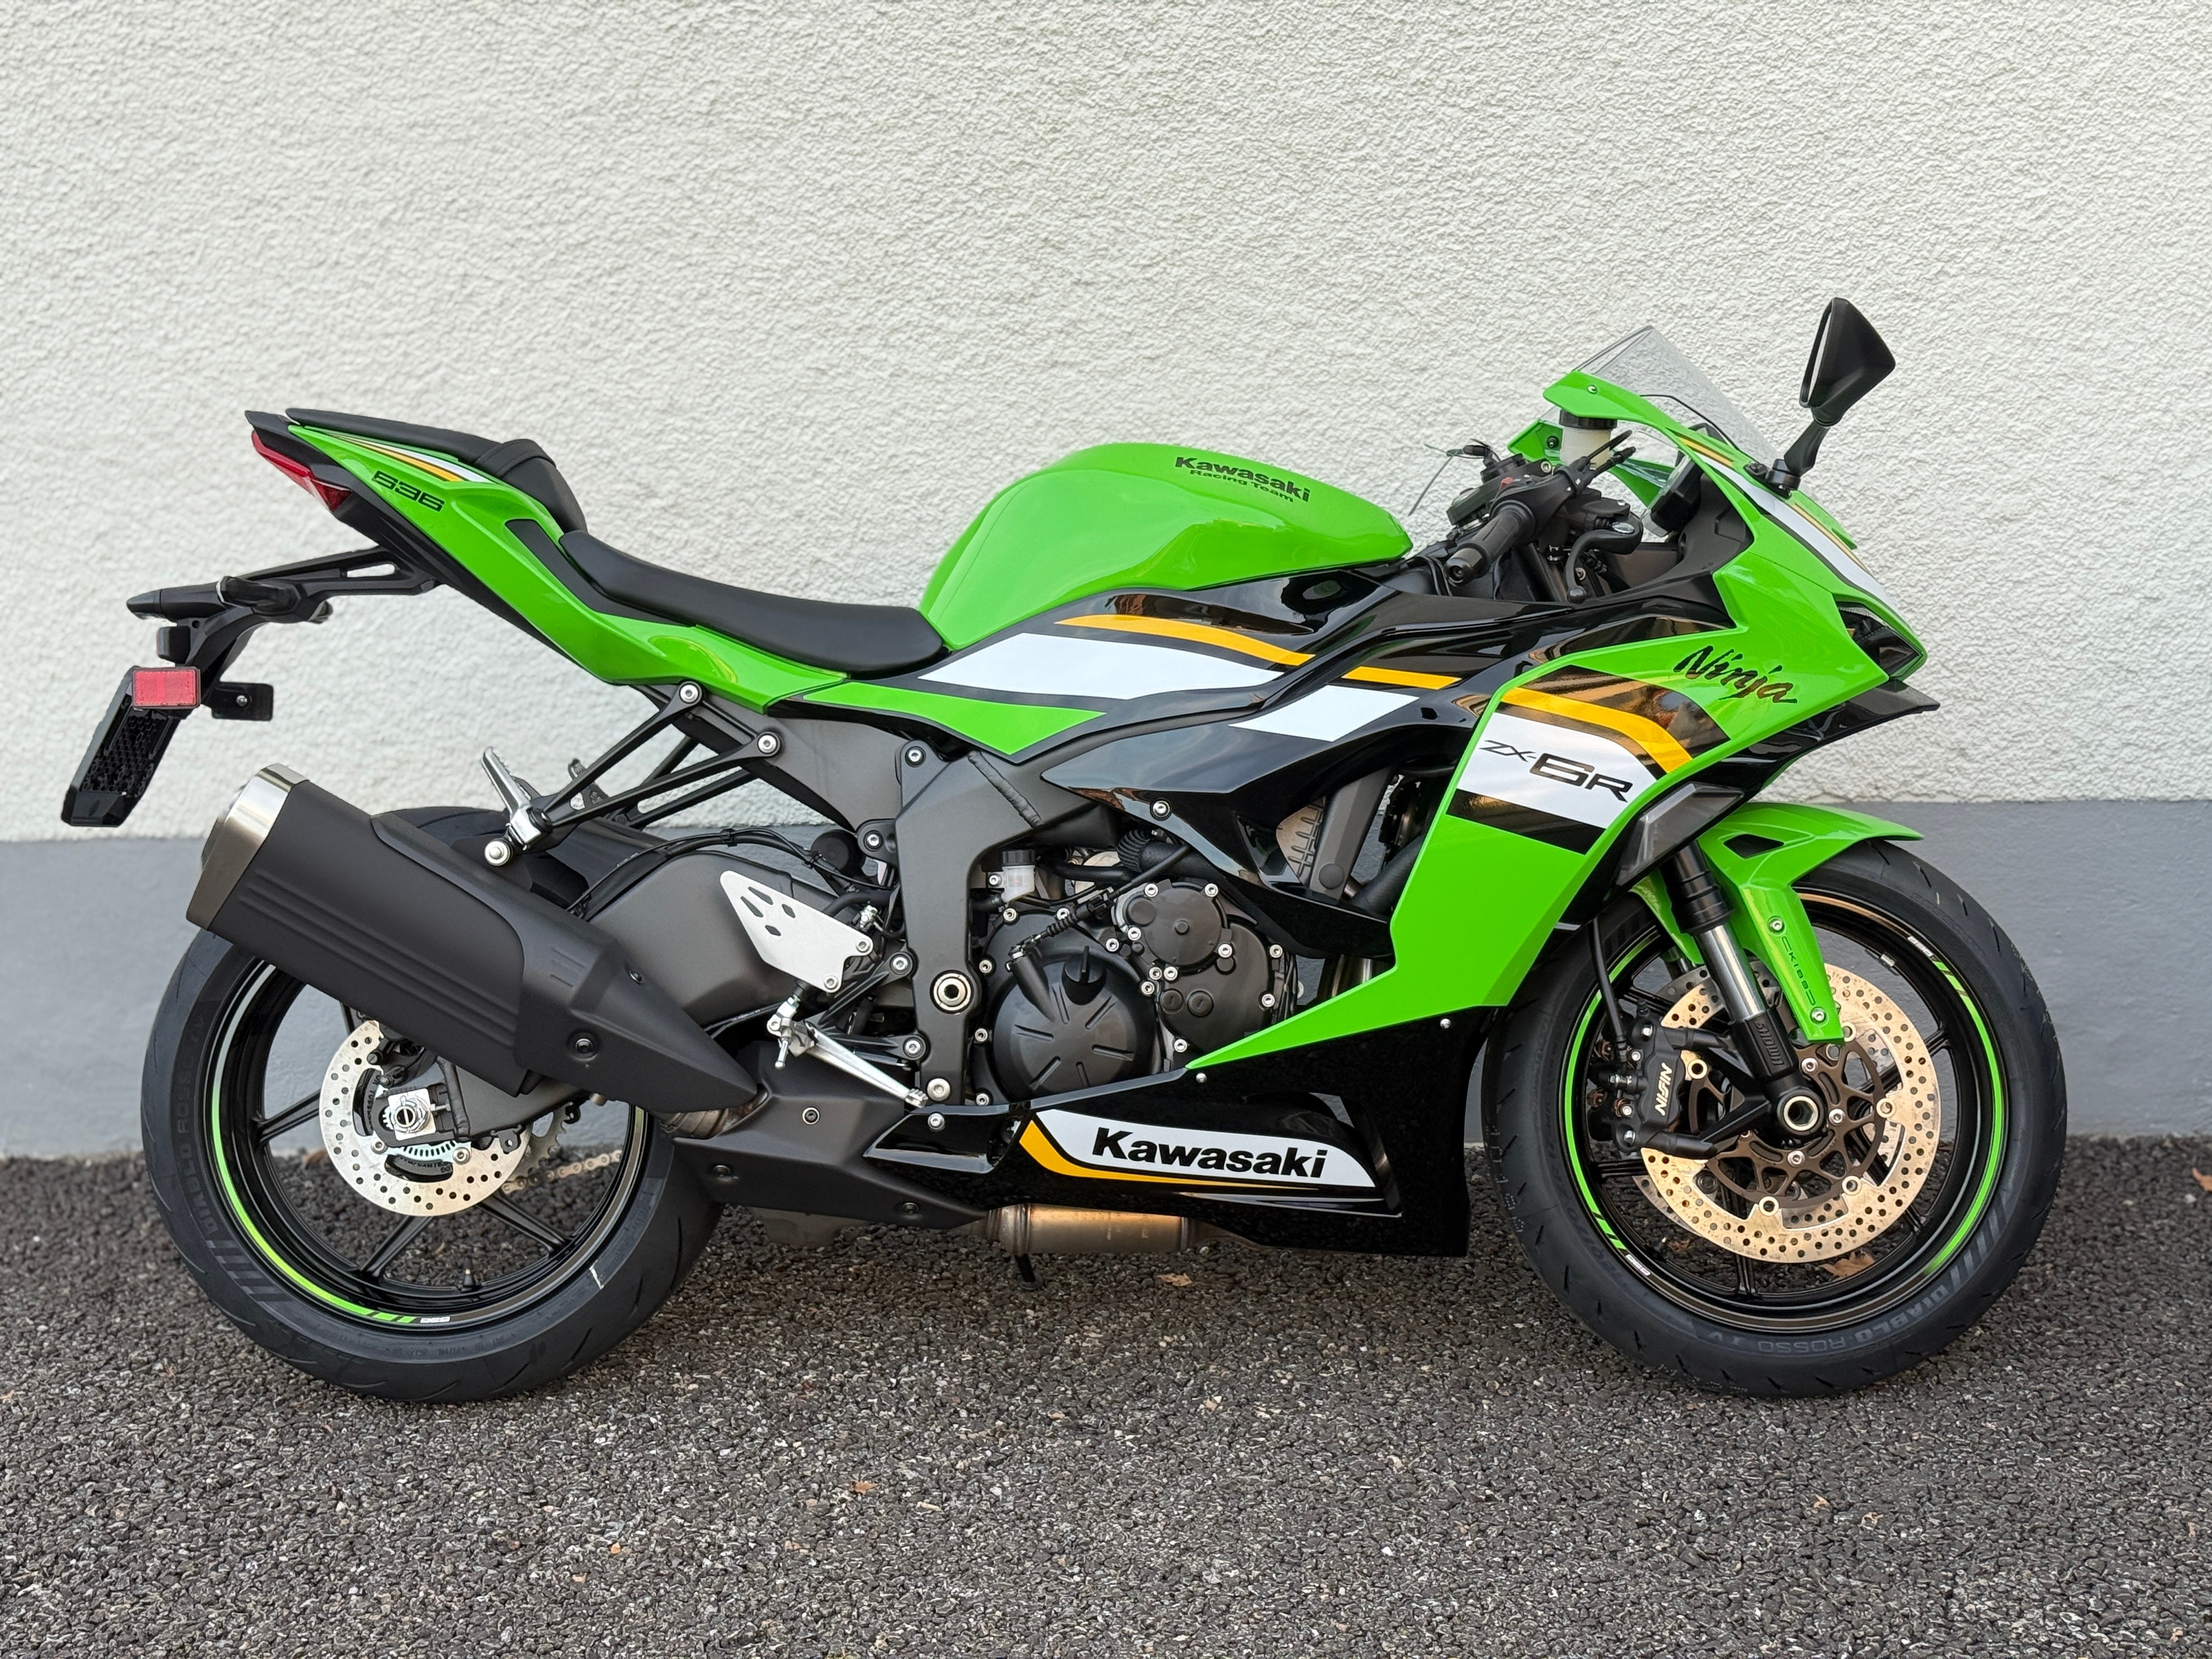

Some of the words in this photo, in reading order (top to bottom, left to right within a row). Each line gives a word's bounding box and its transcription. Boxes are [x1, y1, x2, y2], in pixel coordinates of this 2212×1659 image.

[371, 471, 445, 512] 636
[1175, 457, 1310, 502] Kawasaki
[1189, 470, 1248, 486] Racing
[1251, 481, 1293, 503] Team
[1673, 646, 1798, 703] Ninja
[1755, 1021, 1784, 1066] SHOWA
[177, 1054, 195, 1133] ROSSO
[1092, 1127, 1328, 1178] Kawasaki
[178, 1142, 219, 1234] DIABLO
[1854, 1283, 1951, 1343] DIABLO
[1757, 1336, 1846, 1353] ROSSO
